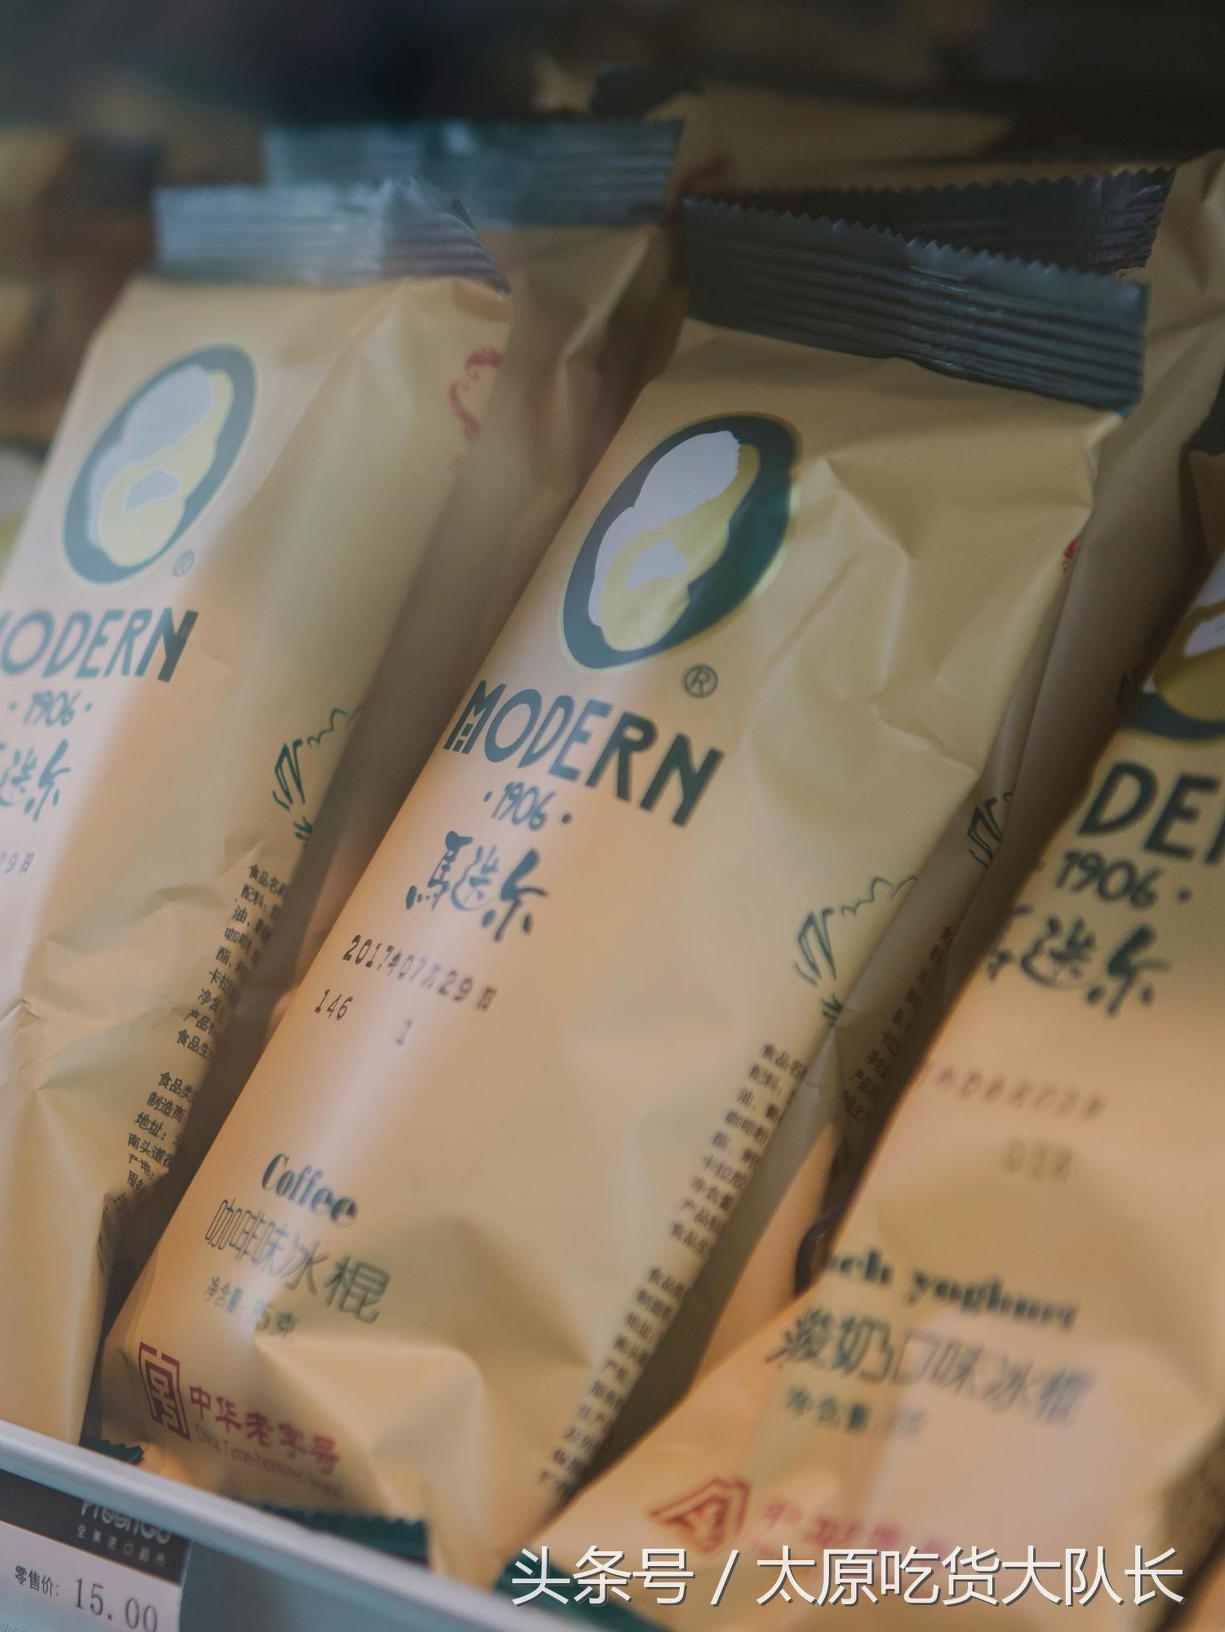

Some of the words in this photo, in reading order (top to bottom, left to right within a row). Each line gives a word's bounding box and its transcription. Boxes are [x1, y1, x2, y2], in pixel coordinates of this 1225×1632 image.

[443, 680, 725, 828] MODERN
[262, 1152, 359, 1228] Coffee
[204, 1197, 392, 1326] 咖啡味冰棍
[189, 1385, 341, 1476] 中华老字号
[75, 1578, 159, 1632] 15.00
